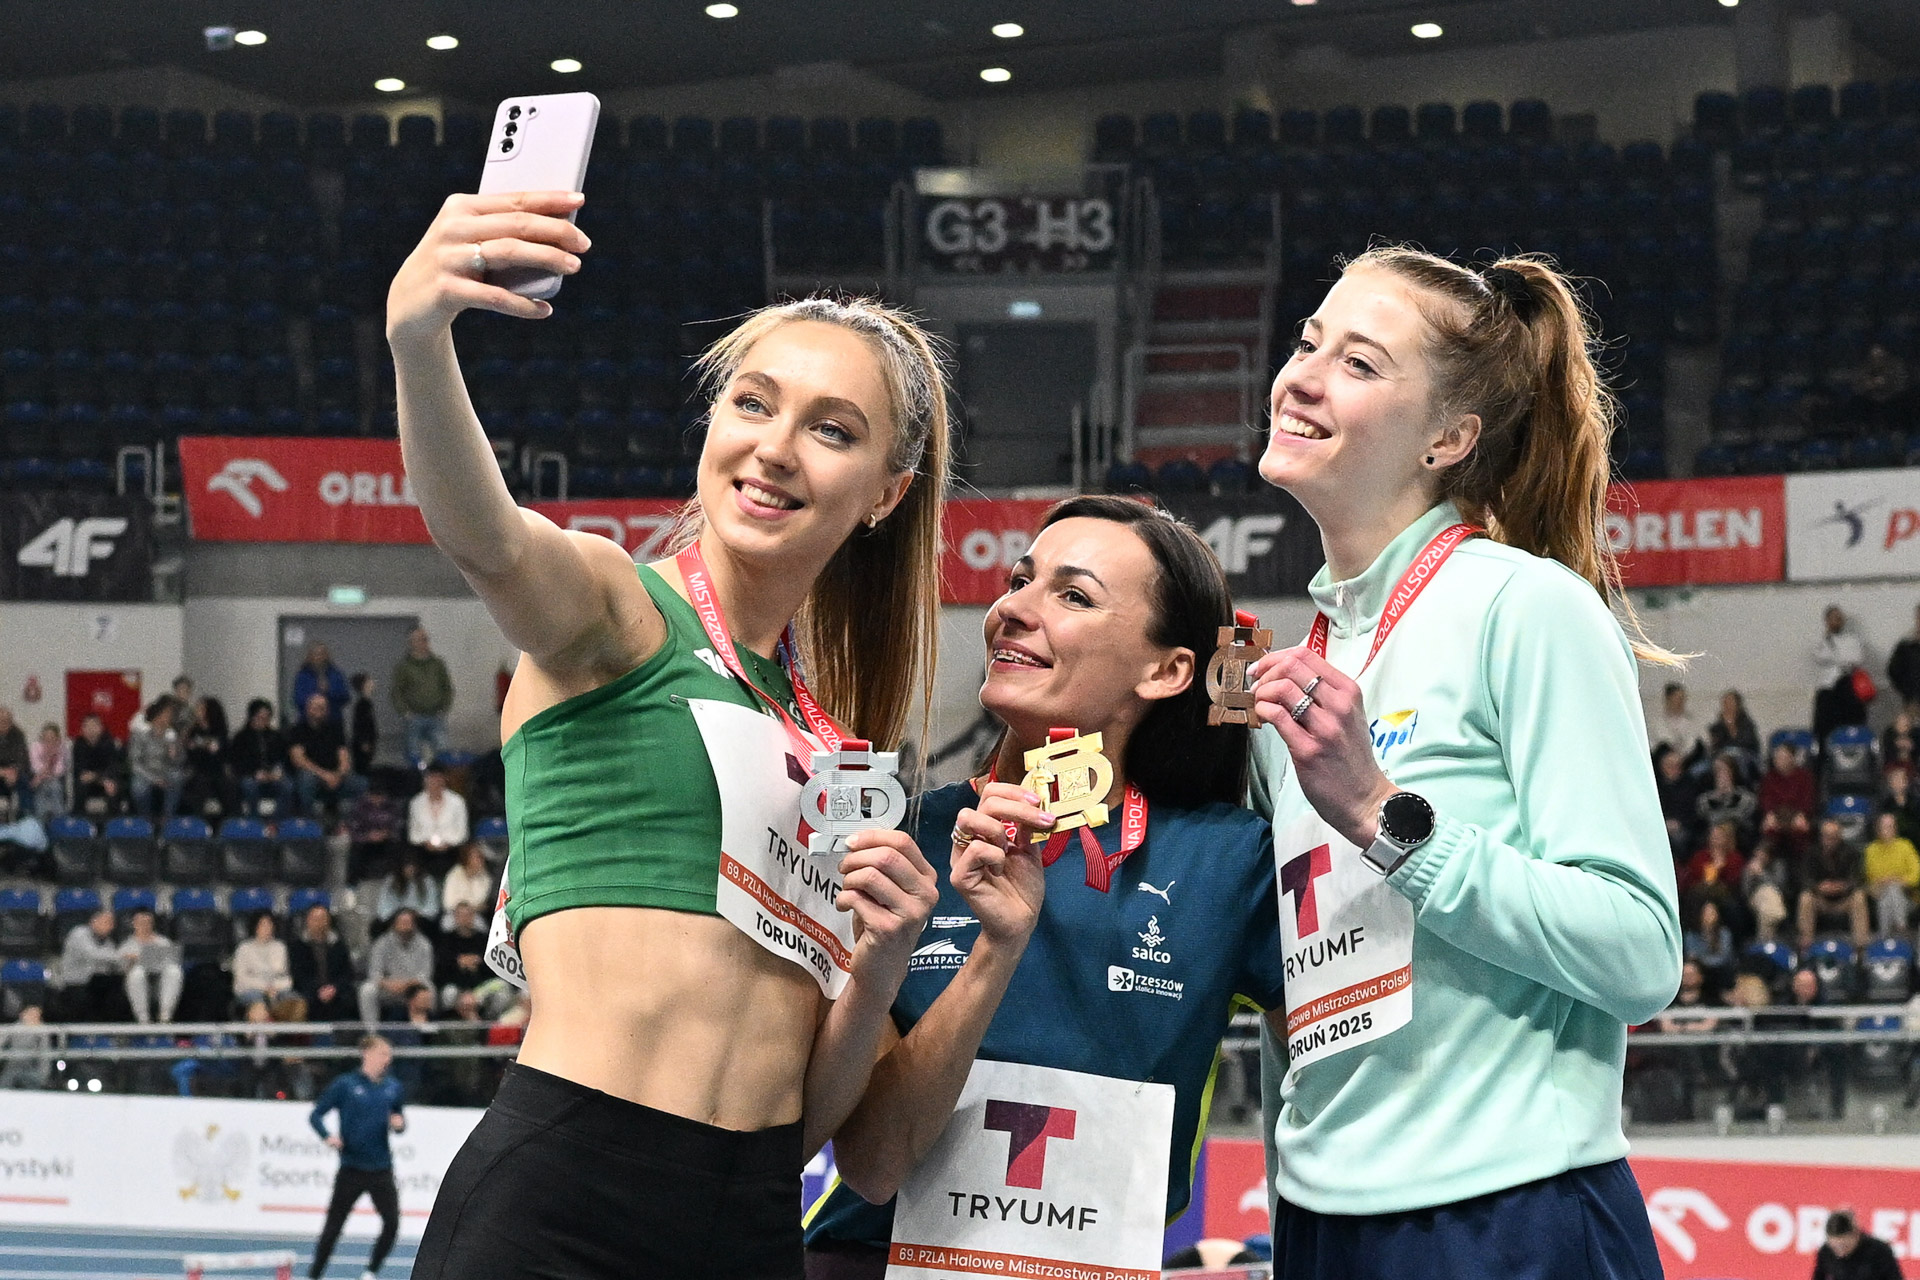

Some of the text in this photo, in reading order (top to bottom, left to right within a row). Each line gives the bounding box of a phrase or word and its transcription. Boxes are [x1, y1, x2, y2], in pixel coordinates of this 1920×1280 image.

[927, 200, 1008, 252] G3
[17, 516, 129, 577] 4F
[1596, 507, 1763, 553] ORLEN
[1387, 525, 1471, 617] MISTRZOSTWA
[1369, 708, 1418, 760] Sopot
[727, 861, 741, 882] 69.
[742, 872, 763, 898] PZLA
[762, 890, 796, 921] Halowe
[767, 826, 843, 905] TRYUMF
[755, 910, 833, 984] TORUŃ 2025
[1131, 946, 1171, 964] salco
[1282, 926, 1364, 982] RYUMF
[1135, 974, 1184, 992] rzeszów
[1288, 968, 1410, 1031] alowe Mistrzostwa Polski
[1289, 1011, 1373, 1061] ORUŃ 2025
[948, 1191, 1098, 1231] TRYUMF
[898, 1247, 916, 1262] 69.
[918, 1250, 946, 1265] PZLA
[949, 1253, 1004, 1270] Halowe
[1008, 1259, 1100, 1280] Mistrzostwa
